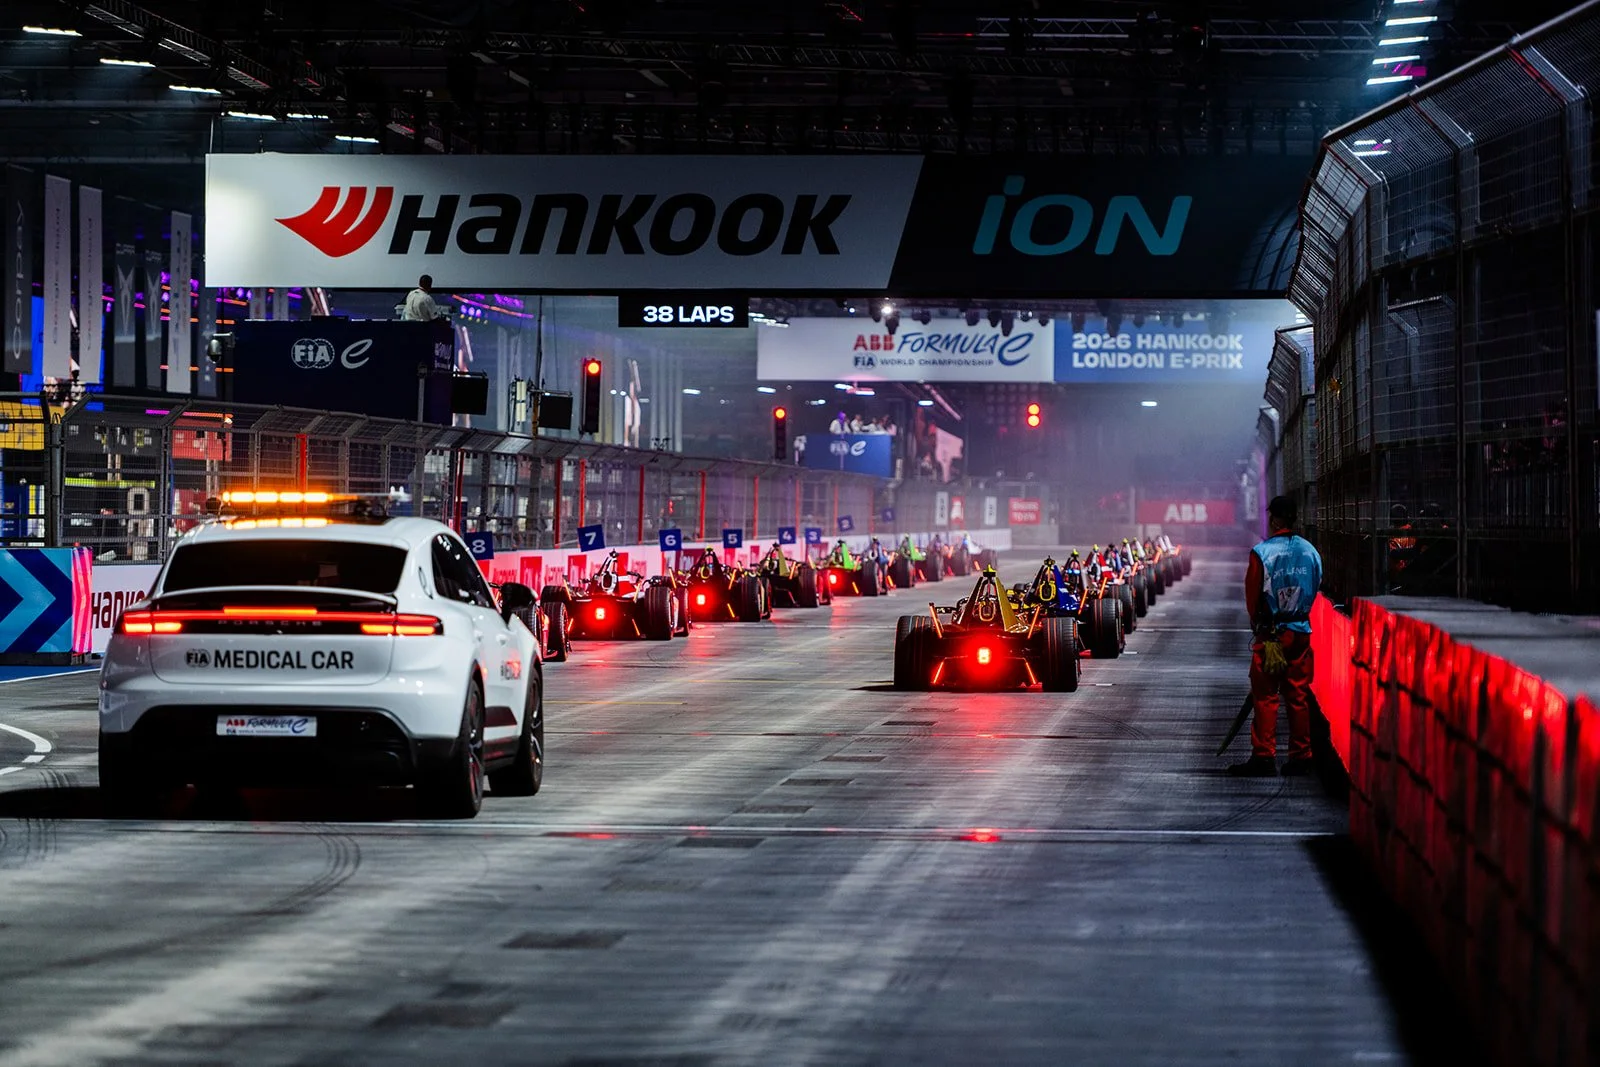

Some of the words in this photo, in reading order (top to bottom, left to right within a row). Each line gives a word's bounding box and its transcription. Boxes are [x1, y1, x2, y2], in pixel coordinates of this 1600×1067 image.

[643, 305, 674, 323] 38
[678, 305, 735, 323] LAPS
[853, 334, 894, 352] ABB
[897, 332, 1000, 354] FORMULA
[1072, 333, 1132, 350] 2026
[1136, 333, 1244, 350] HANKOOK
[880, 358, 915, 366] WORLD
[918, 358, 994, 367] CHAMPIONSHIP
[1072, 352, 1165, 369] LONDON
[1169, 352, 1244, 369] E-PRIX
[1164, 503, 1208, 523] ABB
[585, 531, 597, 545] 7
[664, 535, 677, 546] 6
[727, 534, 738, 544] 5
[782, 531, 792, 541] 4
[471, 539, 486, 554] 8
[217, 619, 324, 627] PORSCHE
[214, 650, 307, 669] MEDICAL
[311, 650, 355, 669] CAR
[226, 718, 246, 727] ABB
